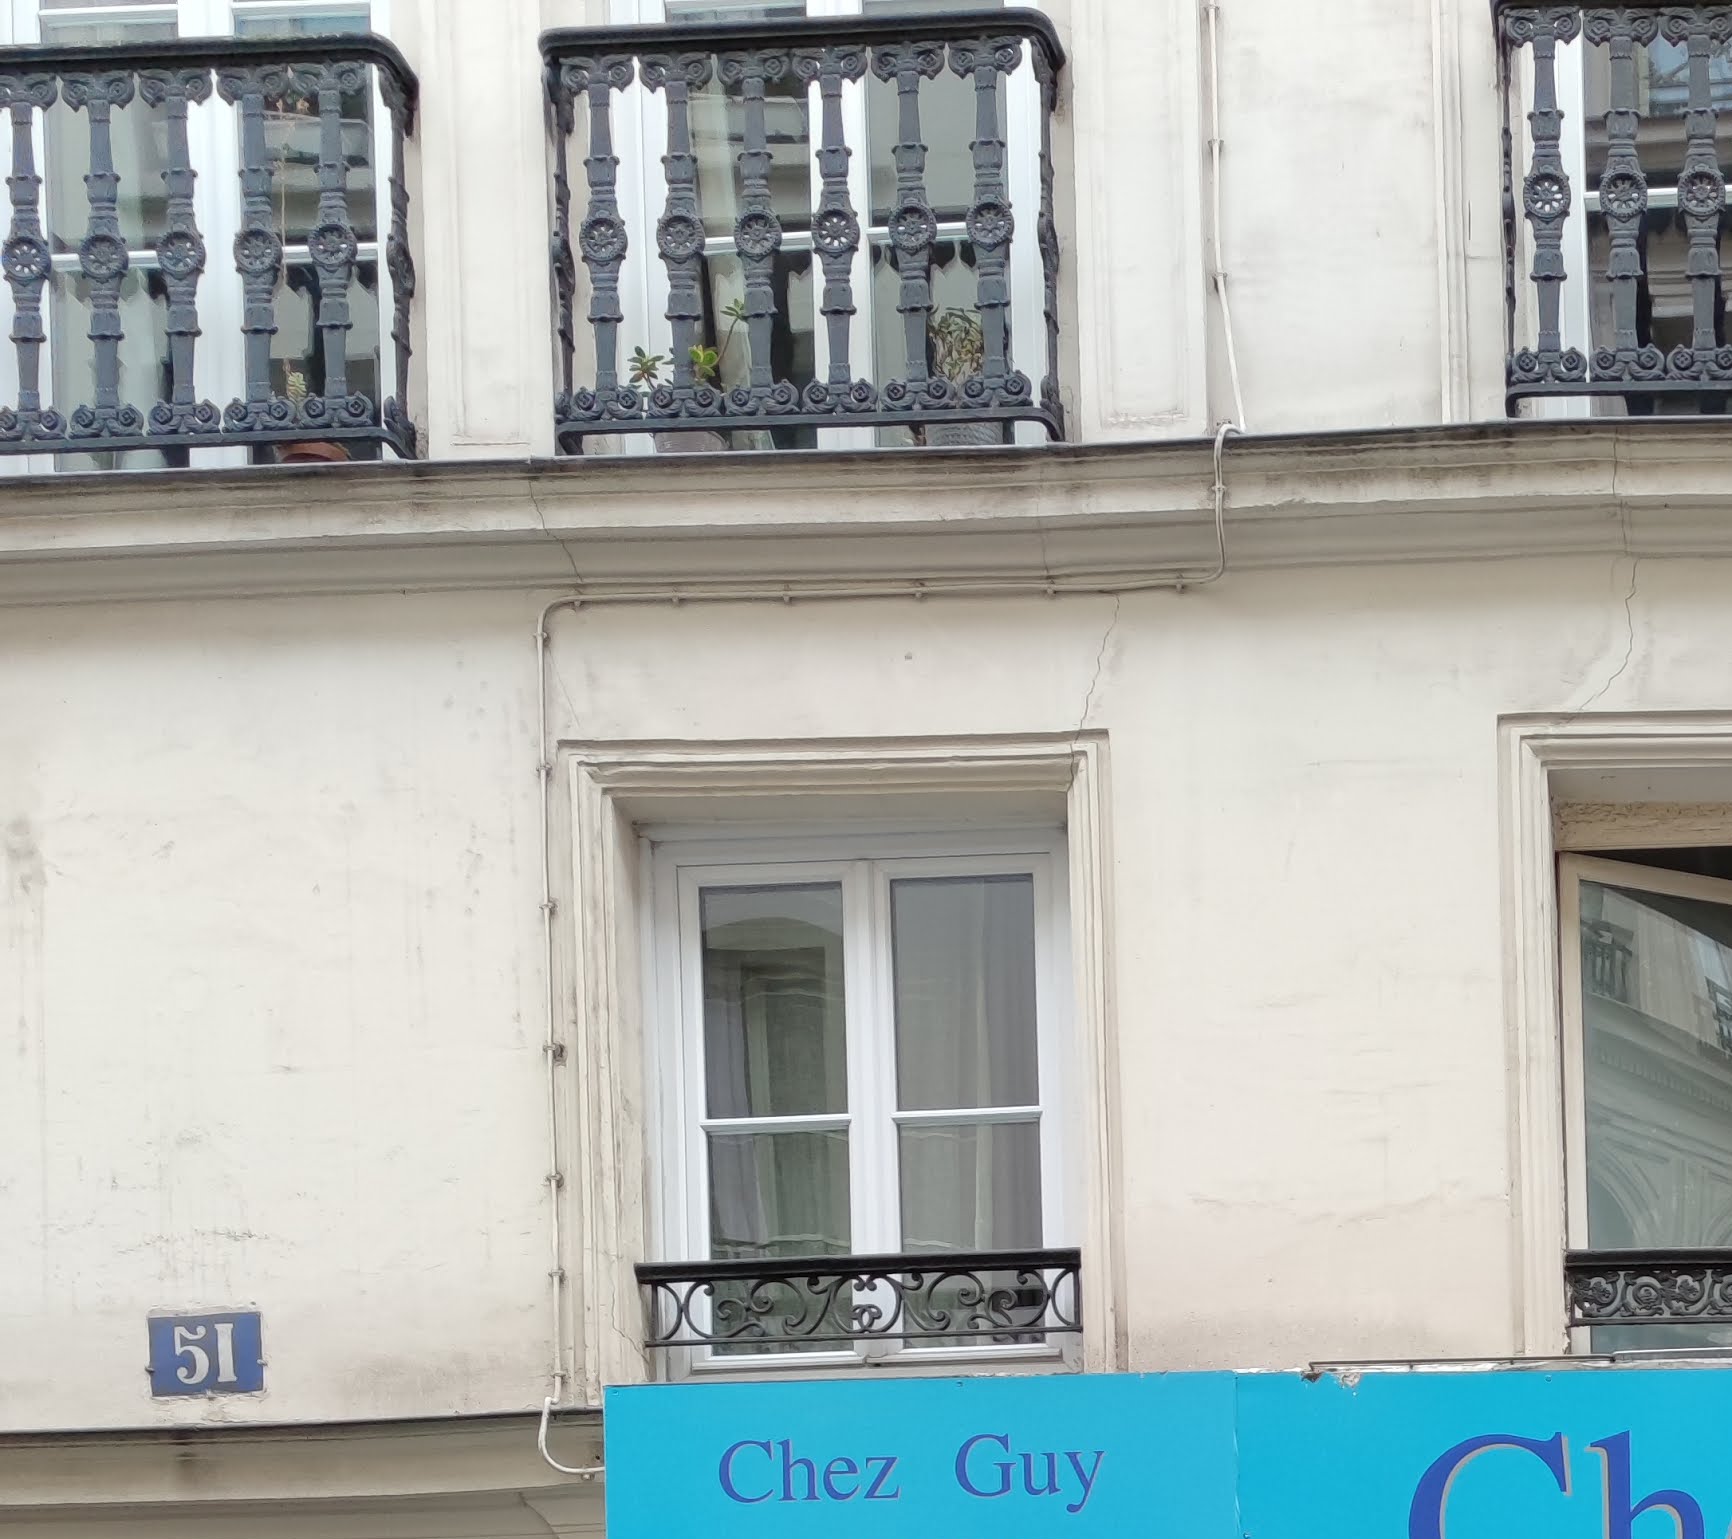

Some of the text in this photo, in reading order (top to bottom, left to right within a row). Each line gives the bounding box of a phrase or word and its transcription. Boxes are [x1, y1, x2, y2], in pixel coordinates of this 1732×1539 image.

[174, 1322, 238, 1385] 51
[718, 1433, 1106, 1514] Chez Guy
